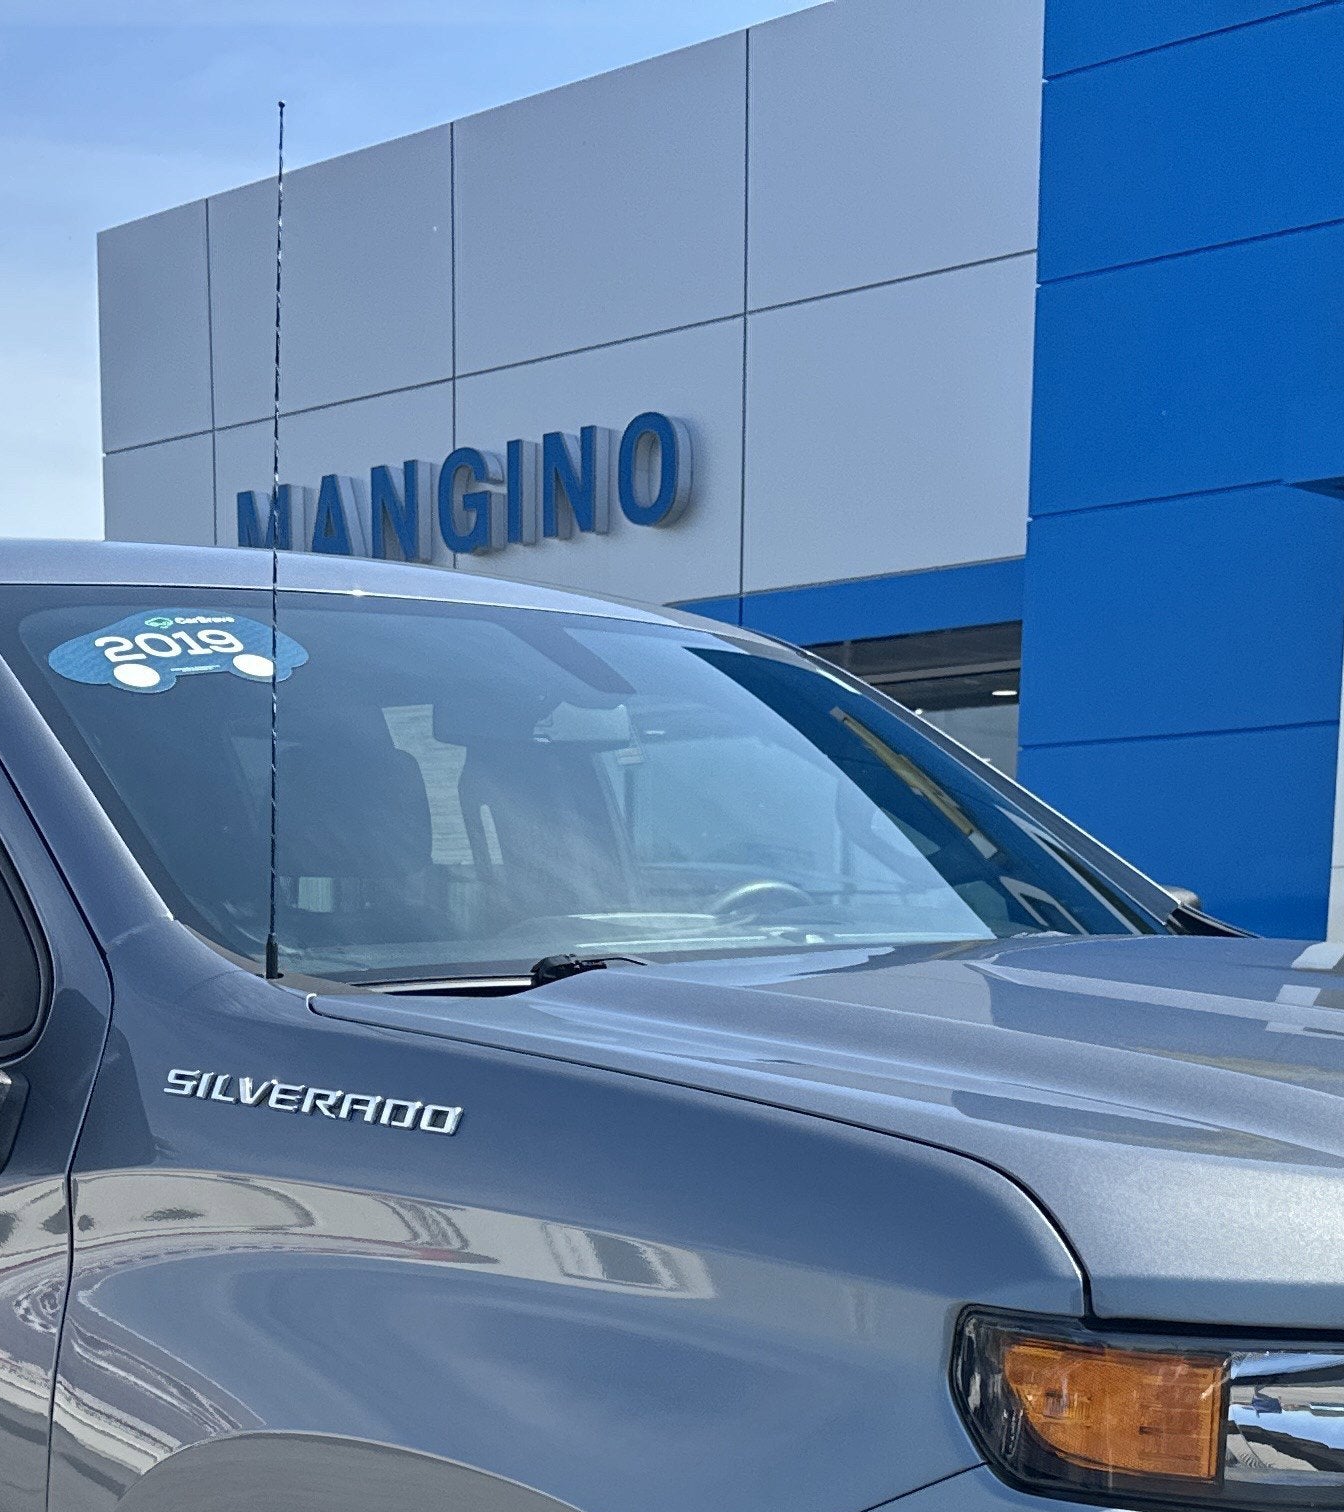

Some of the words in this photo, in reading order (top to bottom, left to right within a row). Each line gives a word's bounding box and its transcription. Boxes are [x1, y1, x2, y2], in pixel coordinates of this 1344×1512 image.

[235, 411, 690, 562] MANGINO
[94, 629, 244, 662] 2019
[163, 1068, 463, 1136] SILVERADO
